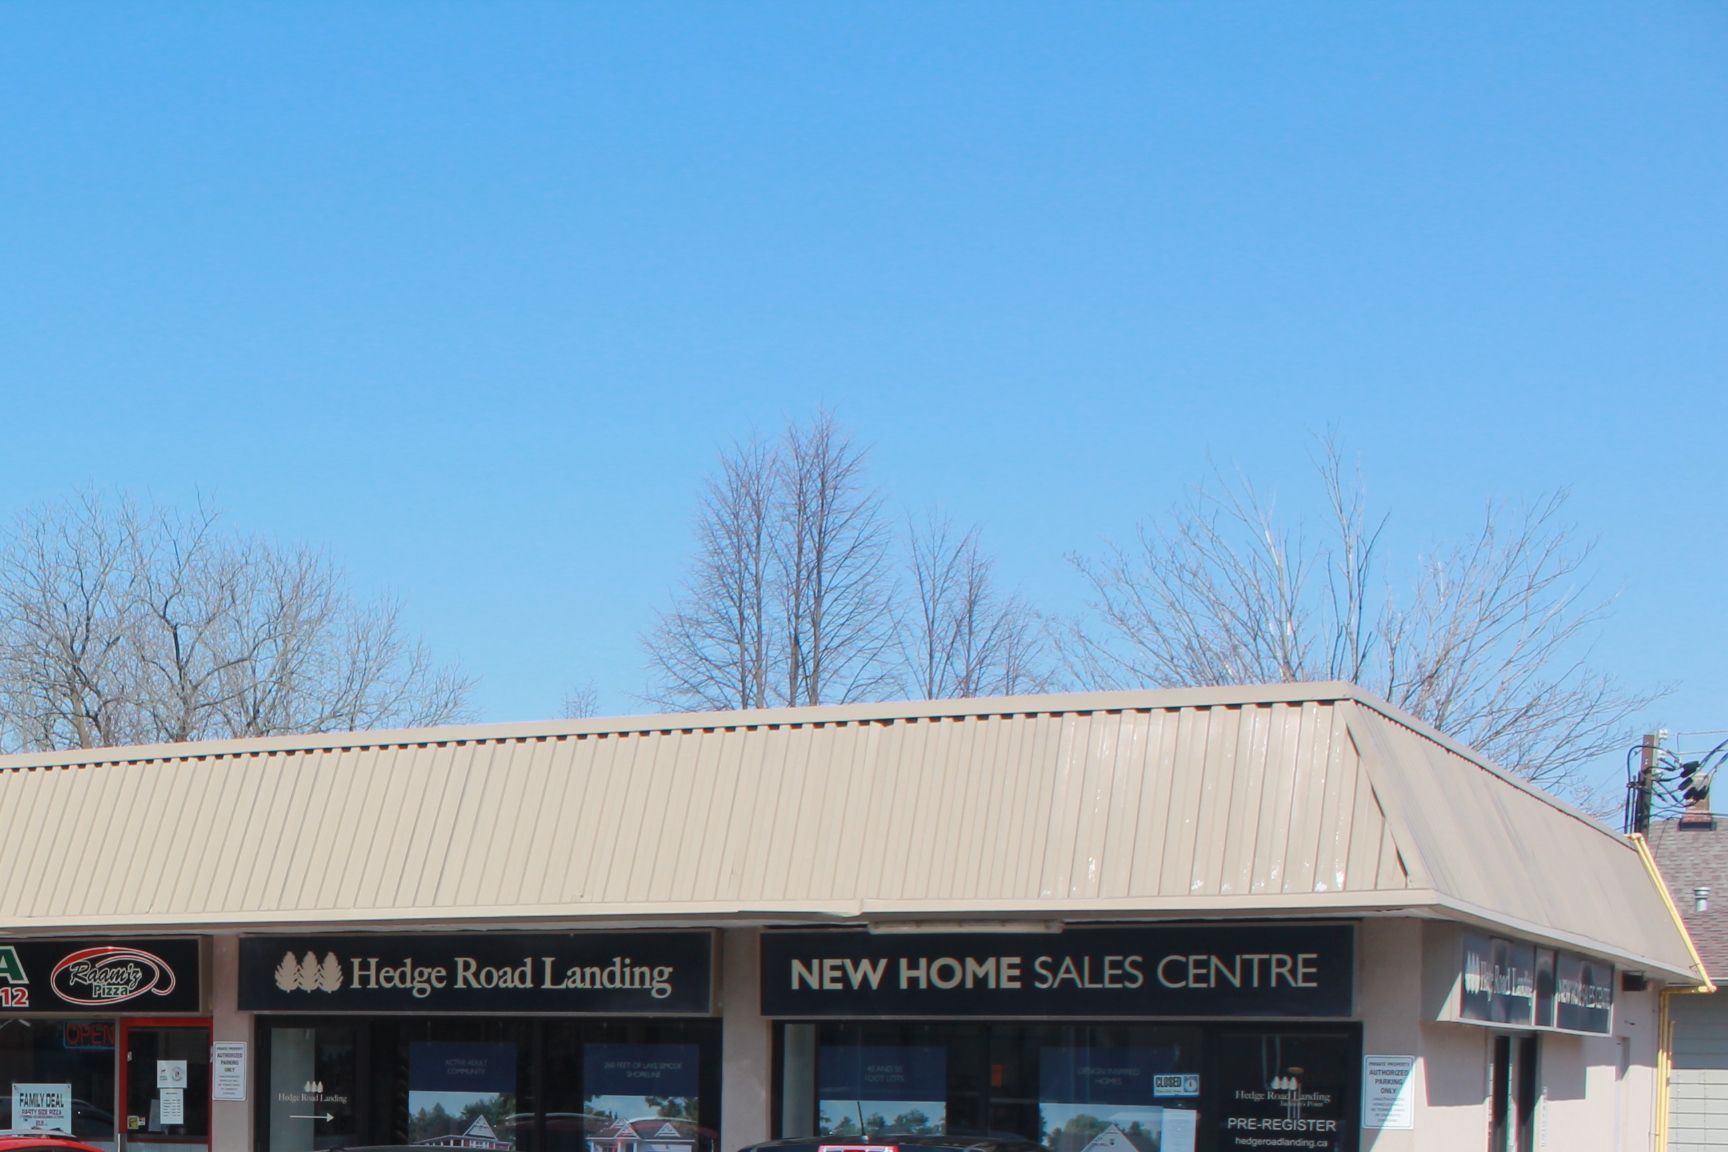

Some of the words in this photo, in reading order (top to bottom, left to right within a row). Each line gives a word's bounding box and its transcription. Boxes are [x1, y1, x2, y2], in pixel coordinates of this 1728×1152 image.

[69, 960, 142, 989] Raam'z
[350, 957, 447, 998] Hedge
[454, 957, 533, 989] Road
[540, 957, 673, 998] Landing
[791, 958, 888, 990] NEW
[899, 957, 1021, 989] HOME
[1033, 955, 1144, 989] SALES
[1156, 953, 1318, 988] CENTRE
[92, 983, 129, 997] Pizza
[66, 1023, 115, 1046] OPEN
[19, 1093, 45, 1107] FAMILY
[46, 1093, 64, 1107] DEAL
[1235, 1090, 1265, 1102] Hedge
[1267, 1090, 1291, 1100] Road
[1292, 1091, 1331, 1103] Landing
[1227, 1117, 1337, 1132] PRE-REGISTER
[1235, 1136, 1329, 1149] hedgeroadlanding.ca
